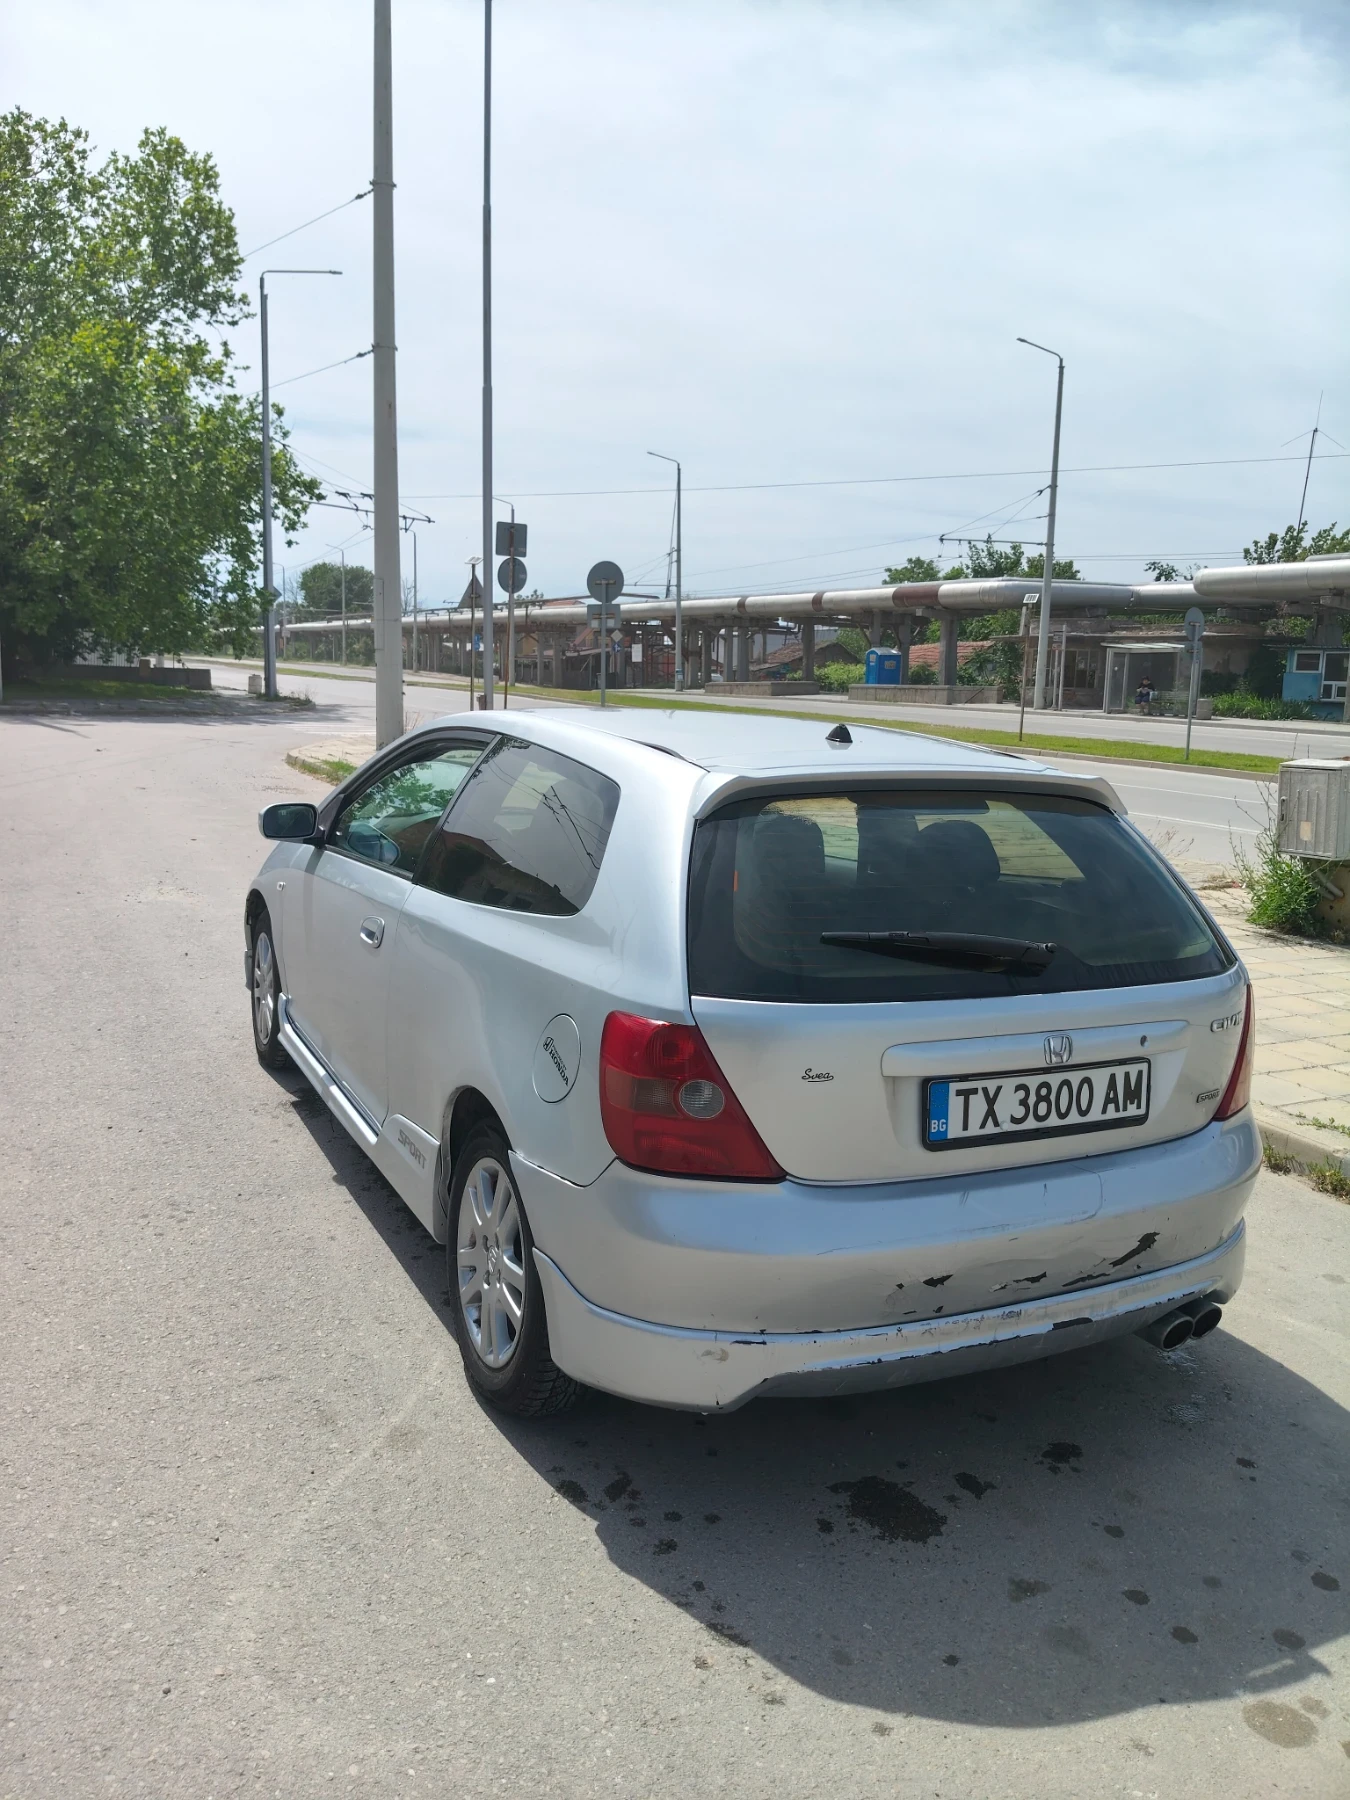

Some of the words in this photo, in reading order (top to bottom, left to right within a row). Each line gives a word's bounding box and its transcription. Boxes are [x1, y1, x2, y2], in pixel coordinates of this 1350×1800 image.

[549, 1047, 569, 1087] HONDA
[801, 1068, 834, 1082] Svea
[955, 1085, 1003, 1131] TX
[1010, 1076, 1094, 1125] 3800
[1101, 1069, 1144, 1115] AM
[930, 1119, 947, 1132] BG
[397, 1129, 427, 1170] SPORT
